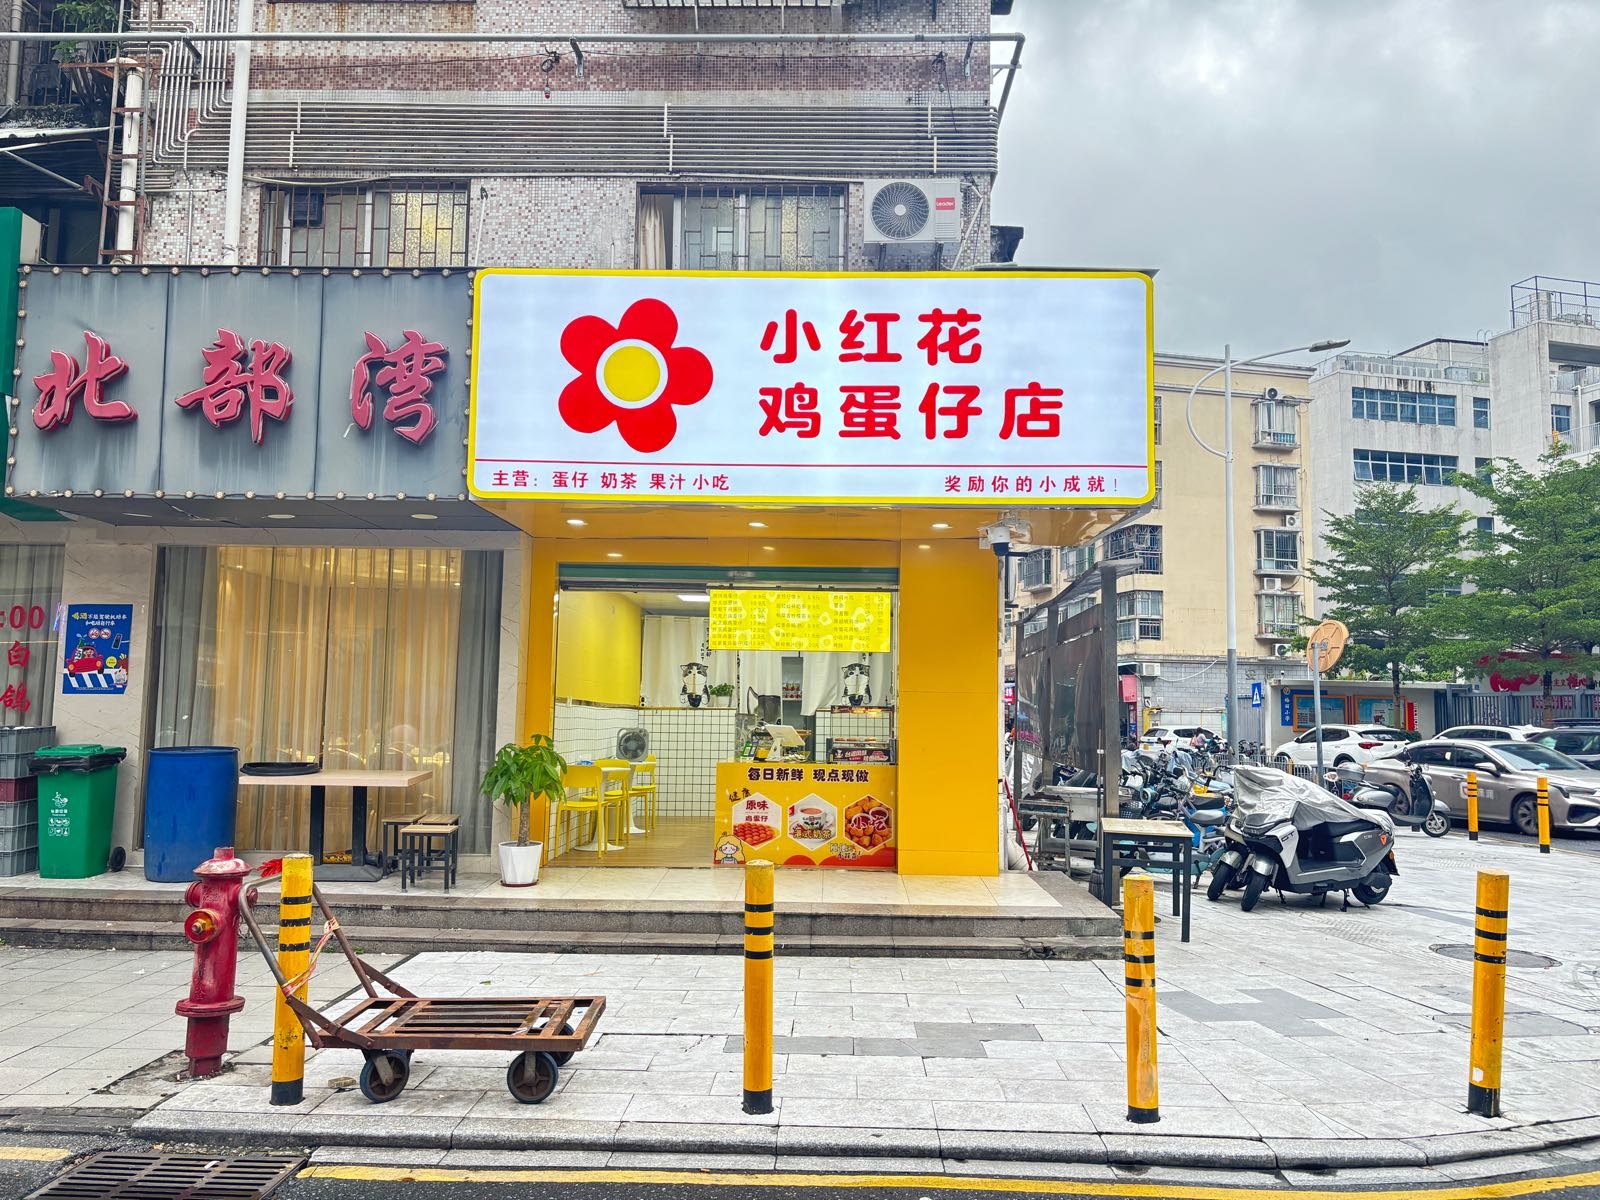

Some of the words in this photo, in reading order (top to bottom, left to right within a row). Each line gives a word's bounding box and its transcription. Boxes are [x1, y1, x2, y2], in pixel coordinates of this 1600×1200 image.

[760, 308, 982, 366] 小红花
[34, 328, 452, 444] 北部湾
[759, 381, 1064, 441] 鸡蛋仔店
[552, 471, 589, 489] 蛋仔
[600, 472, 638, 490] 奶茶
[649, 472, 686, 491] 果汁
[692, 473, 730, 491] 小吃
[747, 767, 804, 782] 每日新鲜
[812, 769, 869, 783] 现点现做
[745, 799, 769, 811] 原味
[745, 815, 769, 823] 鸡蛋仔
